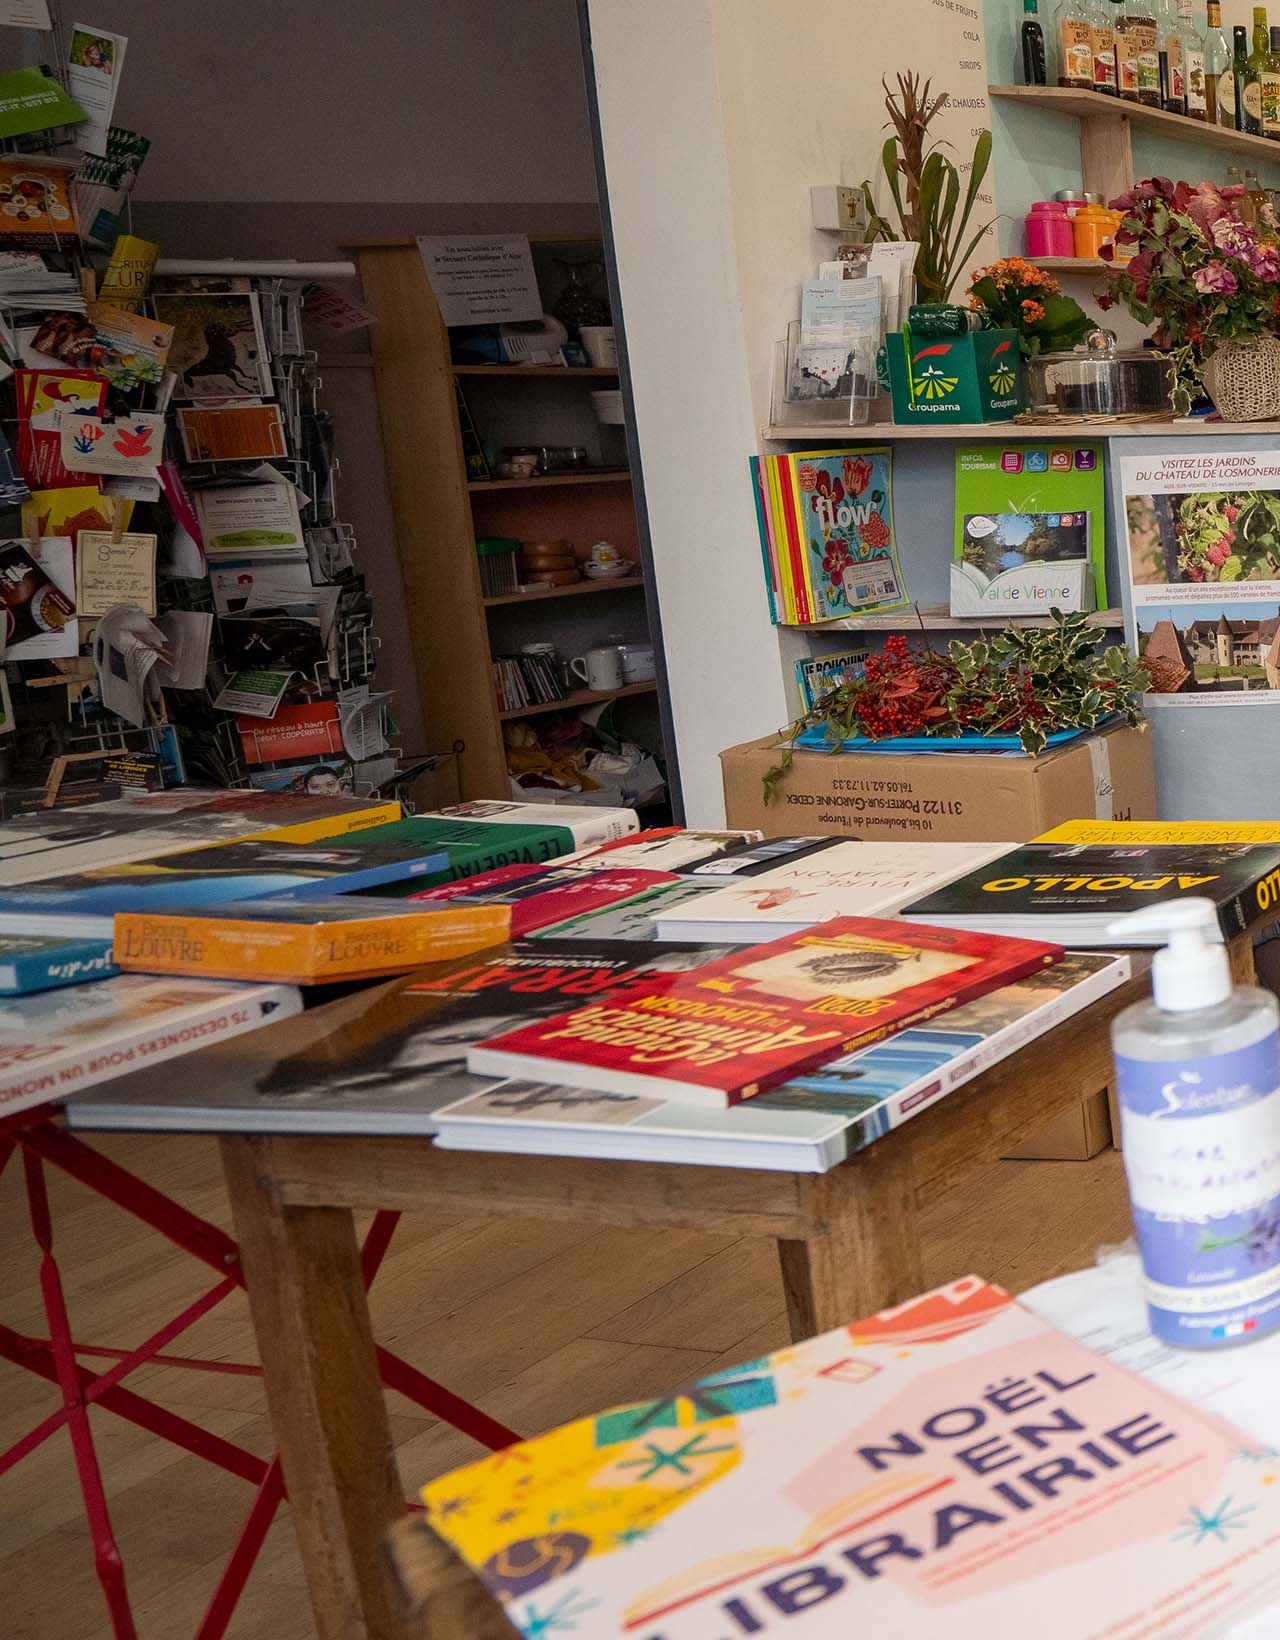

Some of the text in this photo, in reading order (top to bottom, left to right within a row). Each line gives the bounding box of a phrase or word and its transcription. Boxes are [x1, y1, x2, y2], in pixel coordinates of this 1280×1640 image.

[955, 5, 978, 20] FRUITS
[963, 31, 980, 42] COLA
[959, 61, 981, 71] SIROPS
[953, 98, 985, 109] CHAUDES
[908, 402, 961, 412] Groupama
[990, 399, 1018, 410] Groupama
[961, 454, 983, 463] INFOS
[1161, 456, 1256, 469] VISITEZ LES JARDINS
[961, 462, 996, 471] TOURISME
[1135, 472, 1152, 481] DU
[1153, 470, 1201, 481] CHATEAU
[1203, 469, 1217, 479] DE
[815, 495, 872, 530] flow
[1004, 584, 1071, 601] de Vienne
[787, 794, 817, 806] CEDEX
[922, 799, 963, 815] 31122
[348, 814, 388, 829] Gallimard
[818, 813, 852, 827] l'Europe
[853, 815, 865, 826] de
[922, 818, 935, 831] 10
[542, 837, 562, 859] LE
[781, 869, 893, 880] JAPON
[818, 878, 912, 890] VIVRE
[982, 873, 1221, 893] APOLLO
[125, 928, 204, 961] LOUVRE
[329, 936, 407, 963] LOUVRE
[48, 950, 113, 978] jardin
[627, 995, 766, 1026] LIMOUSIN
[803, 996, 897, 1017] 2021
[233, 1010, 250, 1025] 75
[139, 1016, 230, 1056] DESIGNERS
[568, 1006, 842, 1055] Almanach
[544, 1022, 700, 1063] Grand
[88, 1047, 135, 1075] POUR
[59, 1063, 85, 1081] UN
[858, 1369, 1096, 1471] NOËL
[954, 1407, 1087, 1477] EN
[647, 1412, 1177, 1640] IBRAIRIE
